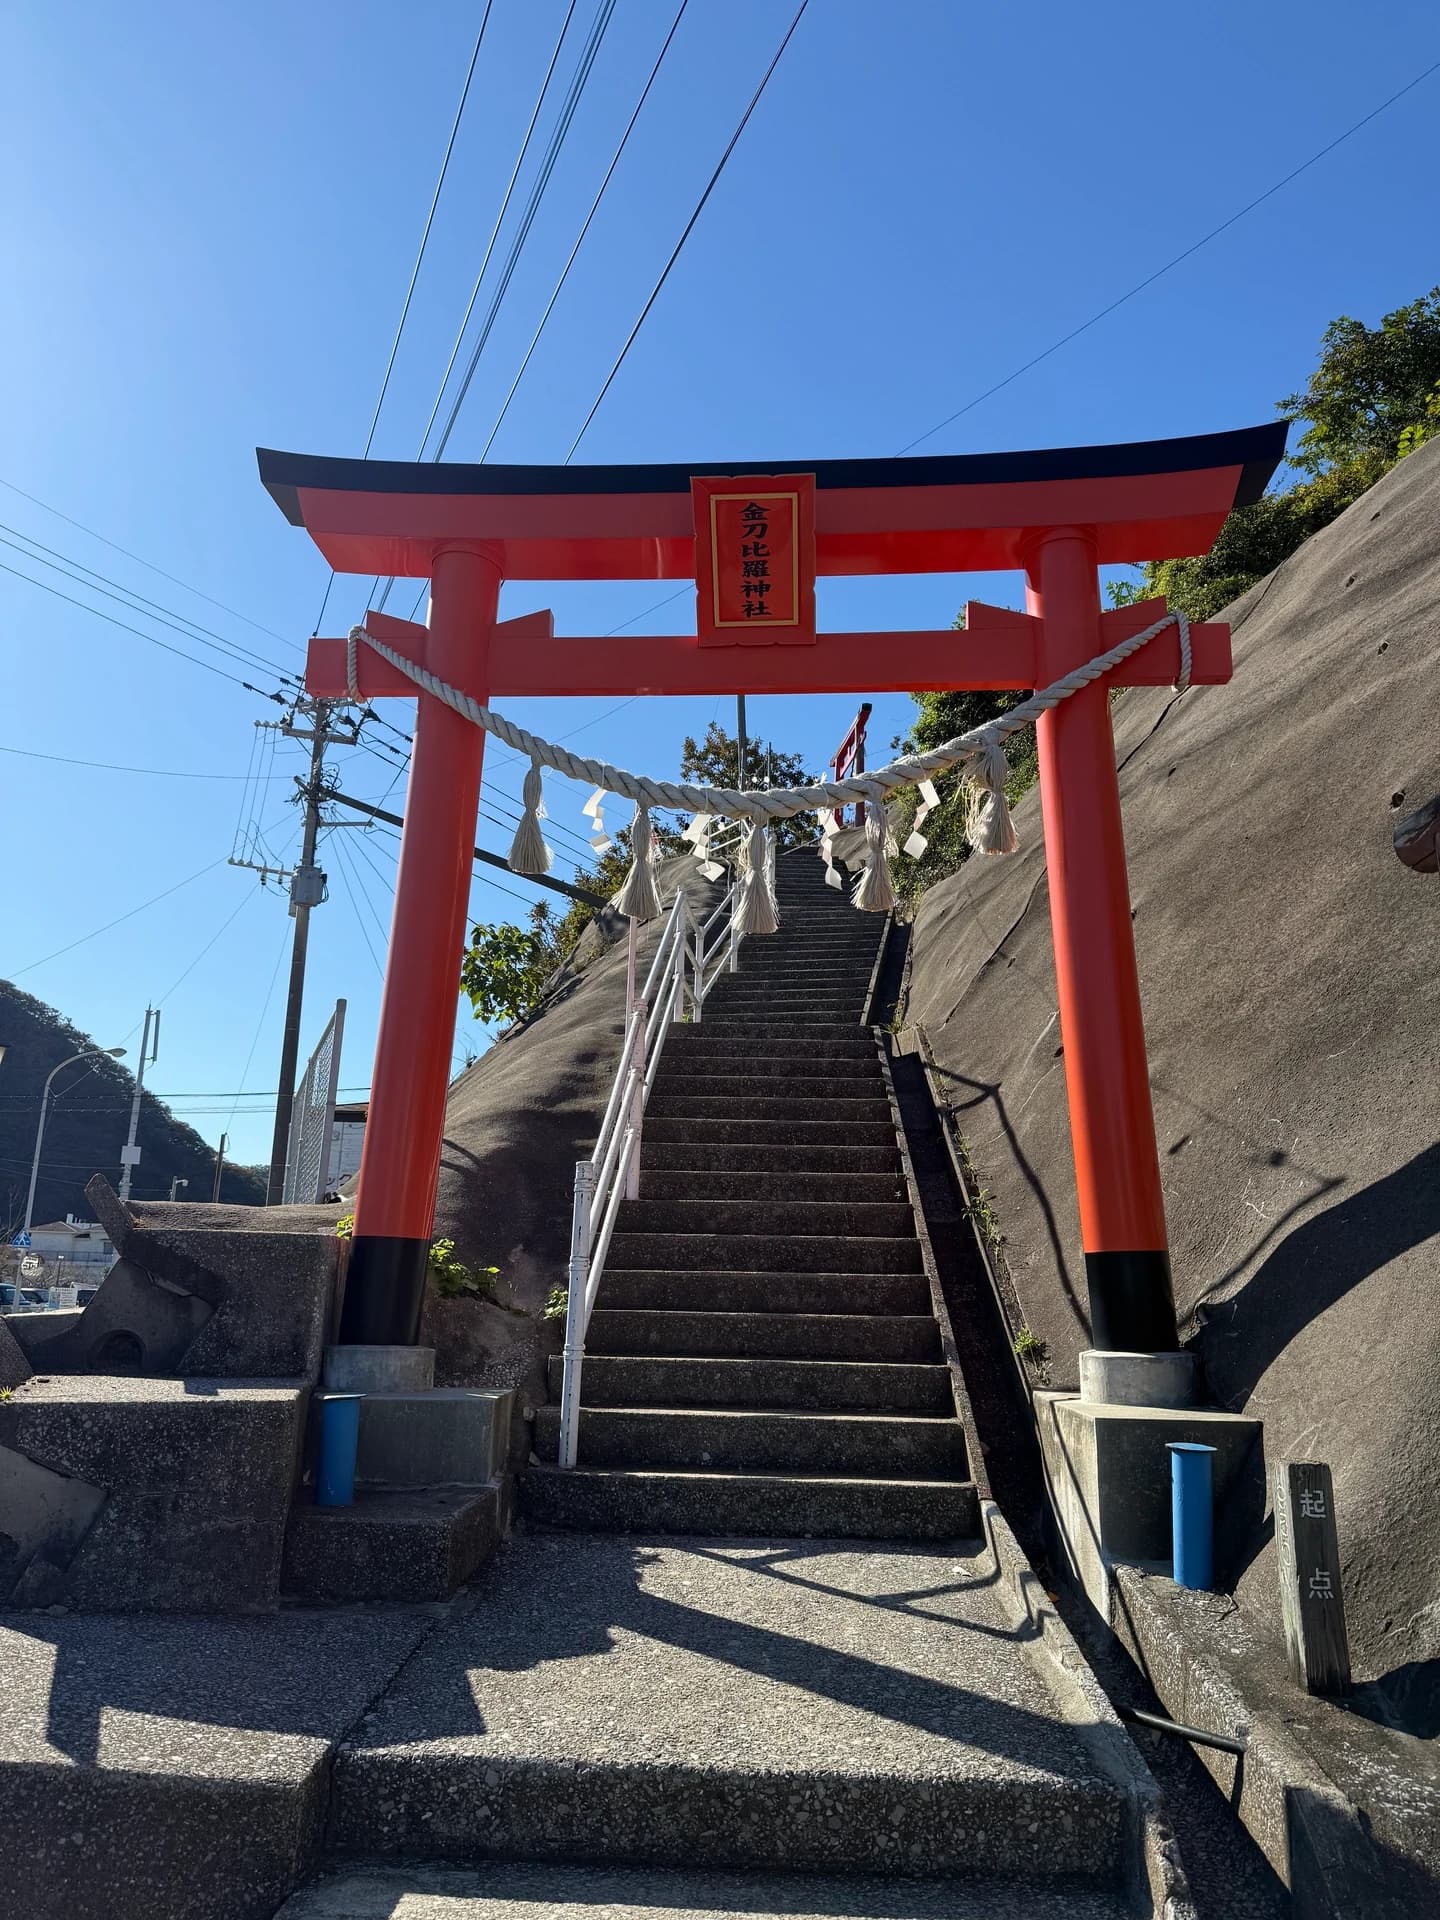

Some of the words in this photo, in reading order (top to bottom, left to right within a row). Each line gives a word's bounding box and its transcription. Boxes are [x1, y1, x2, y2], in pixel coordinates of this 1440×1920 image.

[739, 502, 772, 617] 金刀比羅神社
[1300, 1489, 1334, 1599] 起点
